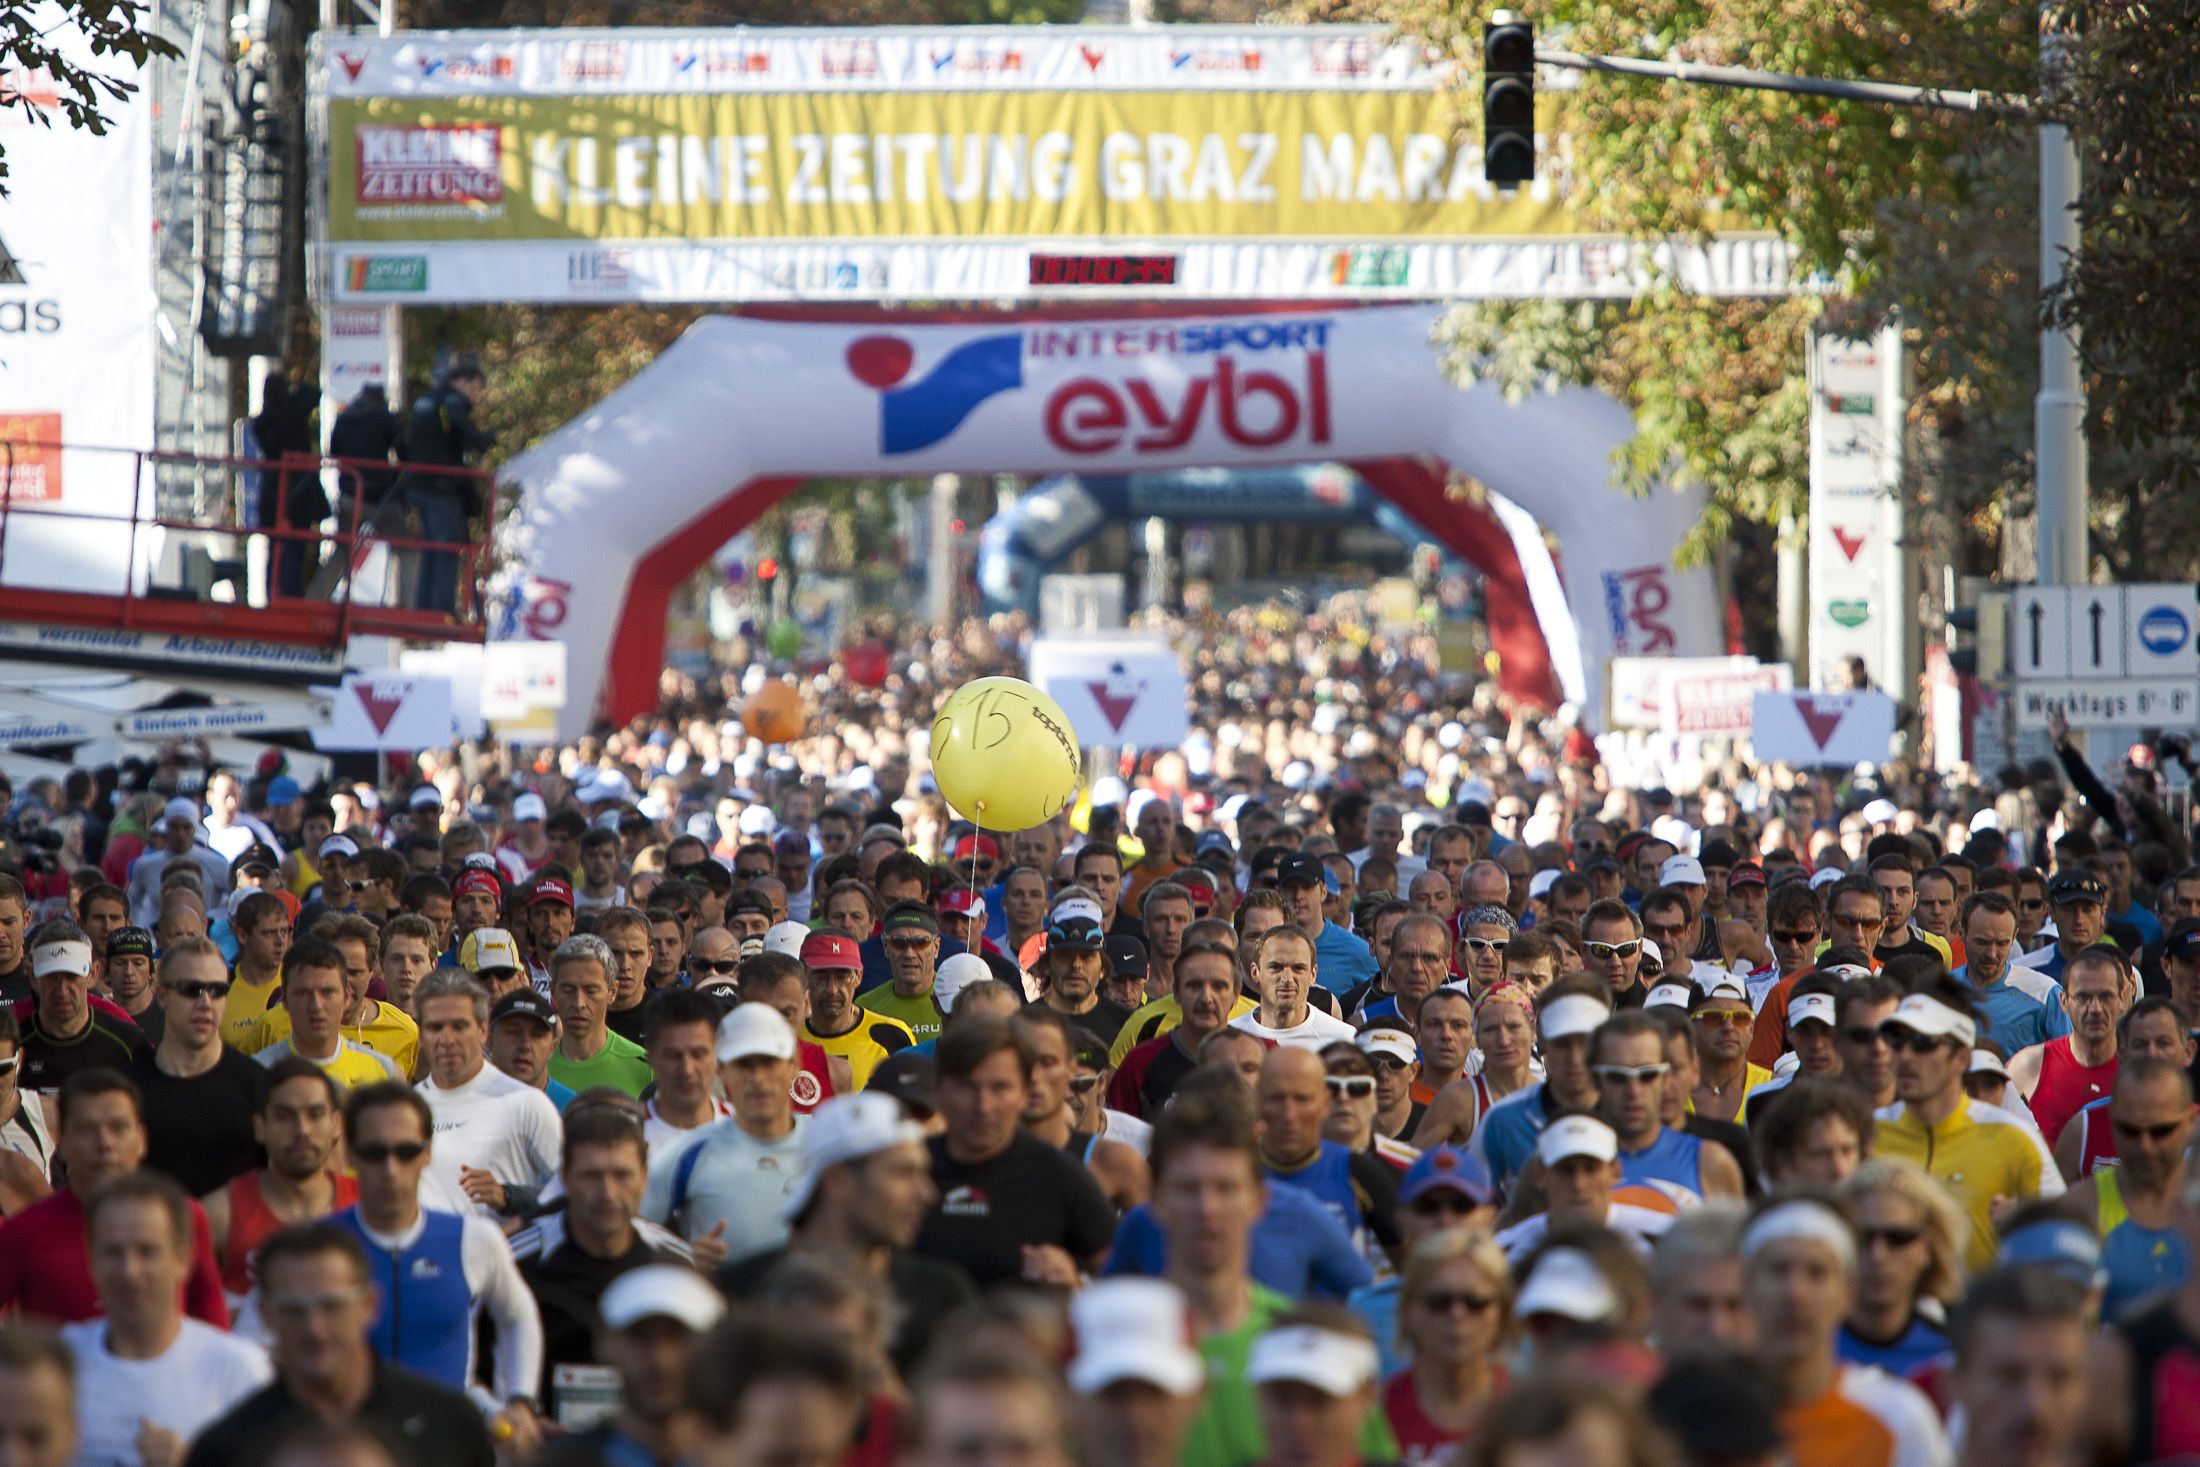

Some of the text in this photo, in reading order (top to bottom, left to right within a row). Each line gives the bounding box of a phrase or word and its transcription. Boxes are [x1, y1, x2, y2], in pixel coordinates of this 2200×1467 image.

[362, 129, 495, 164] KLEINE
[361, 169, 500, 199] ZEITUNG
[531, 134, 770, 208] KLEINE
[788, 132, 1077, 207] ZEITUNG
[1101, 131, 1278, 201] GRAZ
[1031, 318, 1335, 357] INTERSPORT
[1042, 349, 1332, 456] eybl
